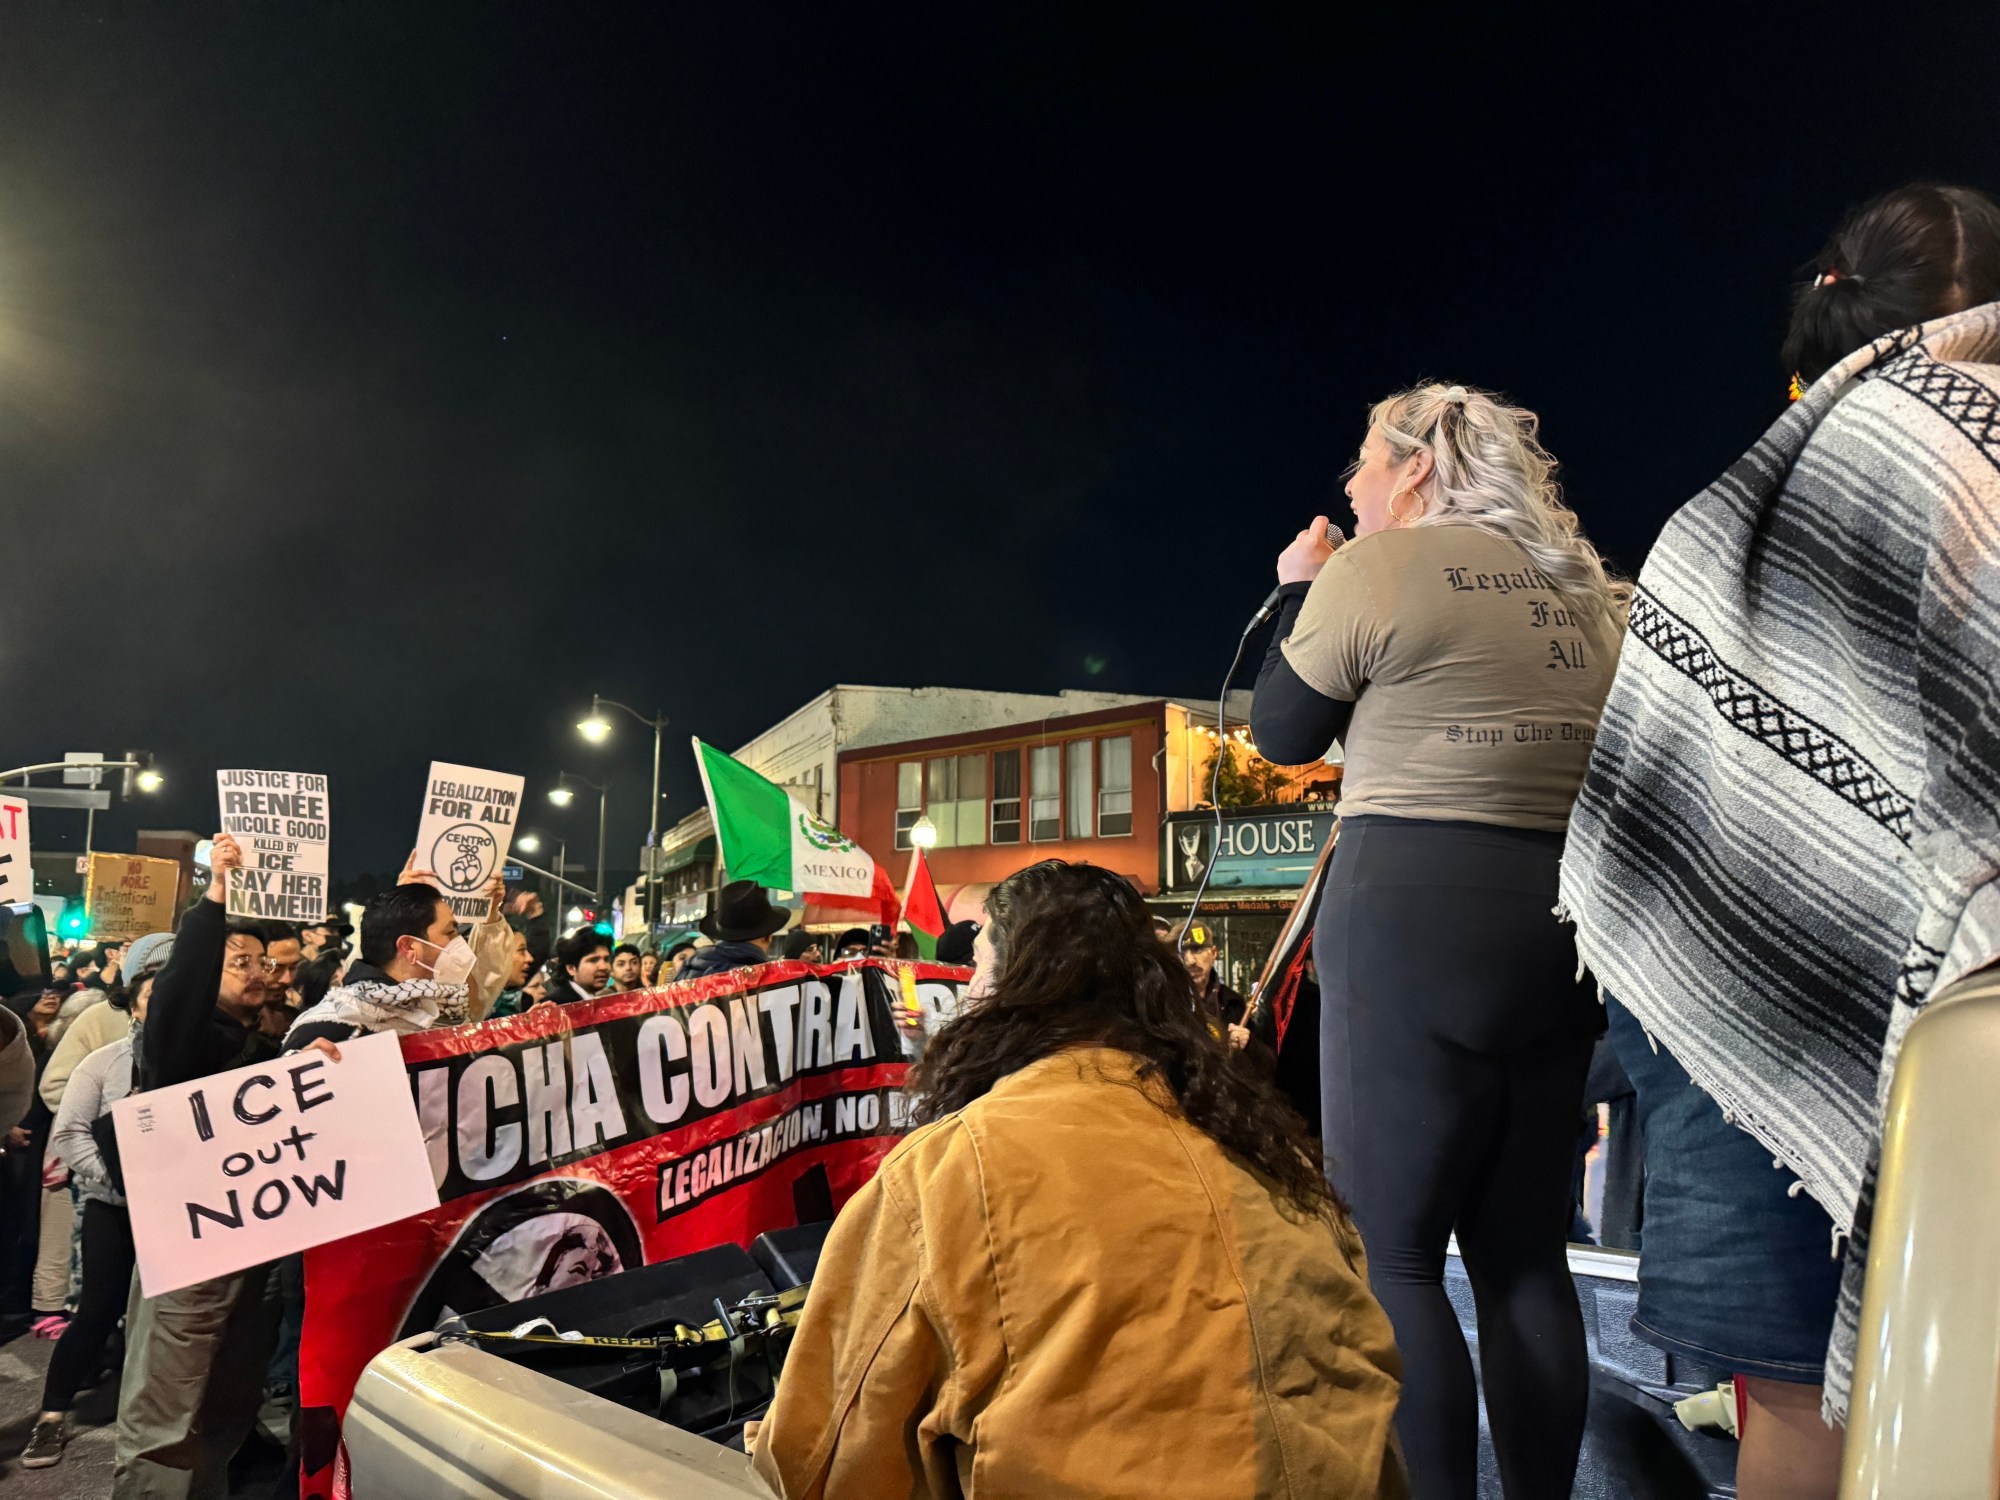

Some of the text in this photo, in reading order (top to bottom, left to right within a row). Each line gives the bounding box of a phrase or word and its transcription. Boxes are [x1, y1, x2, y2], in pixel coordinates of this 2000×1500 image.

[1443, 567, 1558, 594] Legali
[1527, 601, 1577, 627] For
[1546, 640, 1587, 669] All
[1444, 724, 1503, 747] Stop
[1514, 723, 1554, 743] The
[221, 770, 325, 793] JUSTICE FOR
[431, 779, 517, 808] LEGALIZATION
[224, 790, 324, 820] RENÉE
[428, 798, 512, 825] FOR ALL
[0, 805, 22, 840] T
[223, 816, 326, 840] NICOLE GOOD
[253, 838, 299, 853] KILLED BY
[446, 833, 492, 848] CENTRO
[457, 844, 480, 855] CSO
[1215, 820, 1315, 857] HOUSE
[128, 861, 142, 876] NO
[258, 854, 294, 871] ICE
[803, 864, 868, 880] MEXICO
[120, 875, 150, 890] MORE
[230, 867, 322, 897] SAY HER
[229, 889, 323, 920] NAME!!!
[636, 973, 877, 1124] CONTRA
[188, 1060, 334, 1142] ICE
[835, 1094, 880, 1134] NO
[185, 1159, 346, 1239] NOW
